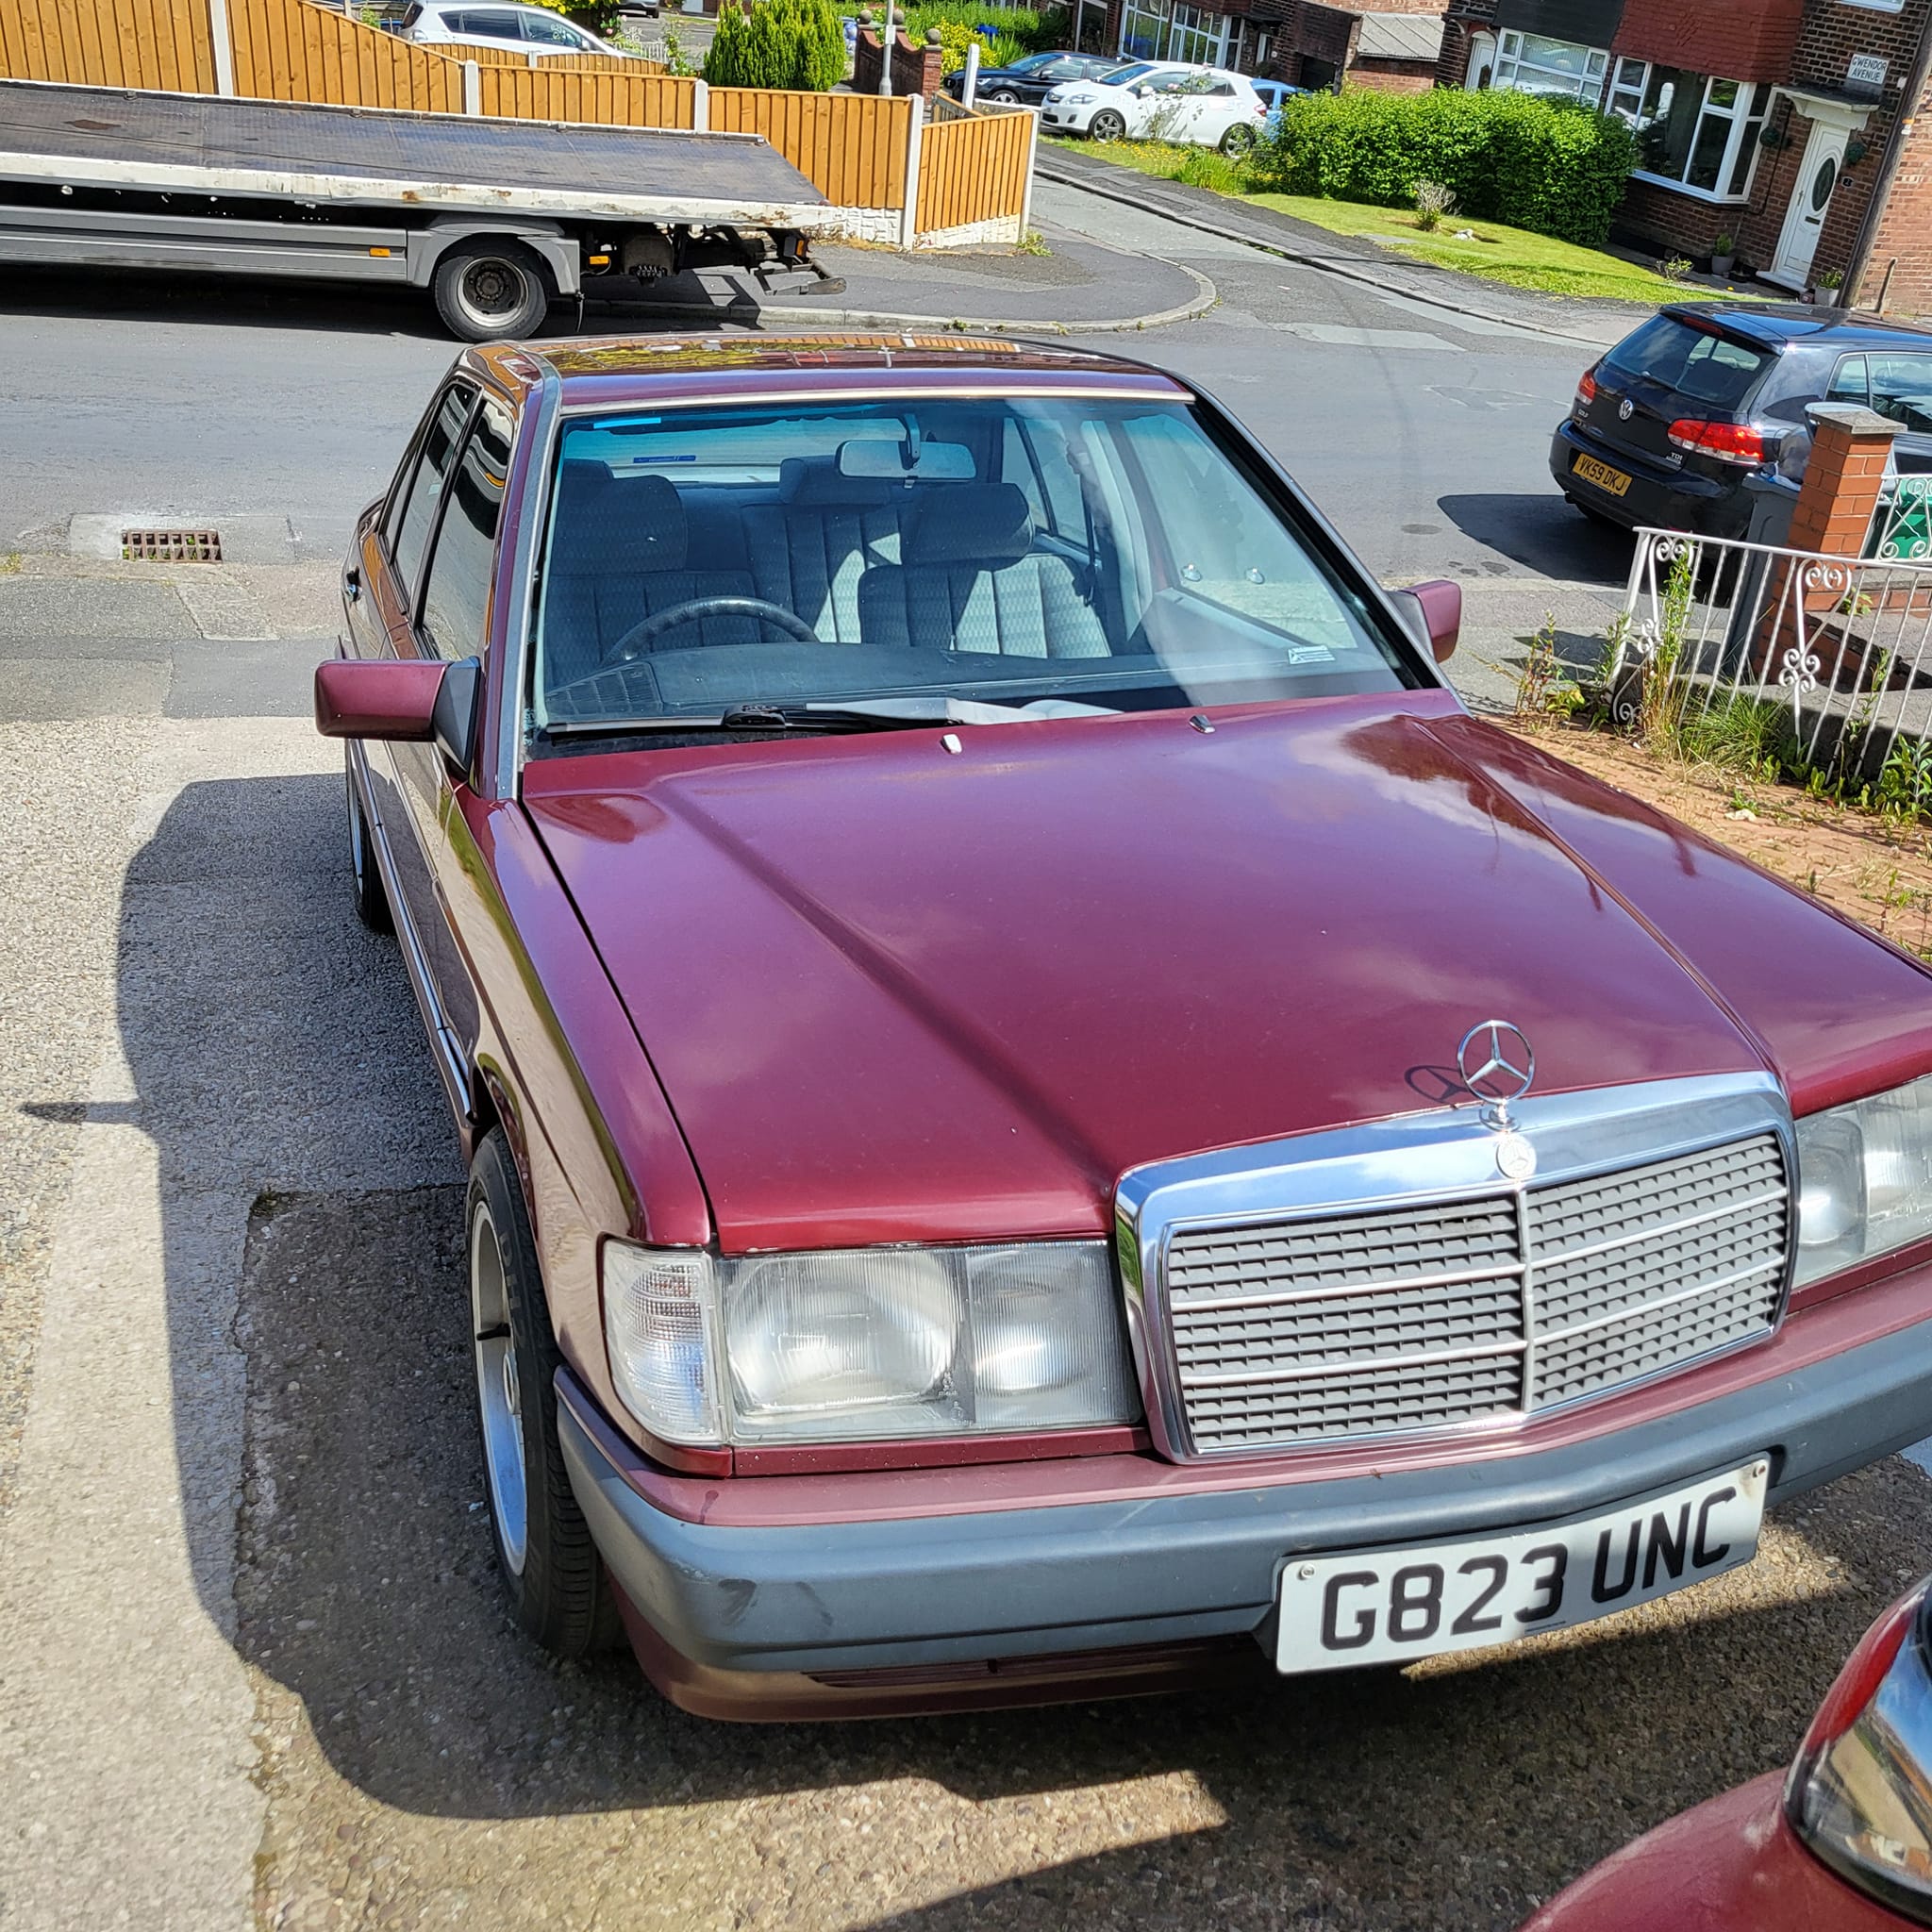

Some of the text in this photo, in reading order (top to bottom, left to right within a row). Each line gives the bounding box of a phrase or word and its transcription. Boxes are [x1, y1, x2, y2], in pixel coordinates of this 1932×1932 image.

[1852, 68, 1880, 81] AVENUE
[1579, 457, 1627, 491] VK59 DKJ
[1322, 1486, 1737, 1651] G823 UNC
